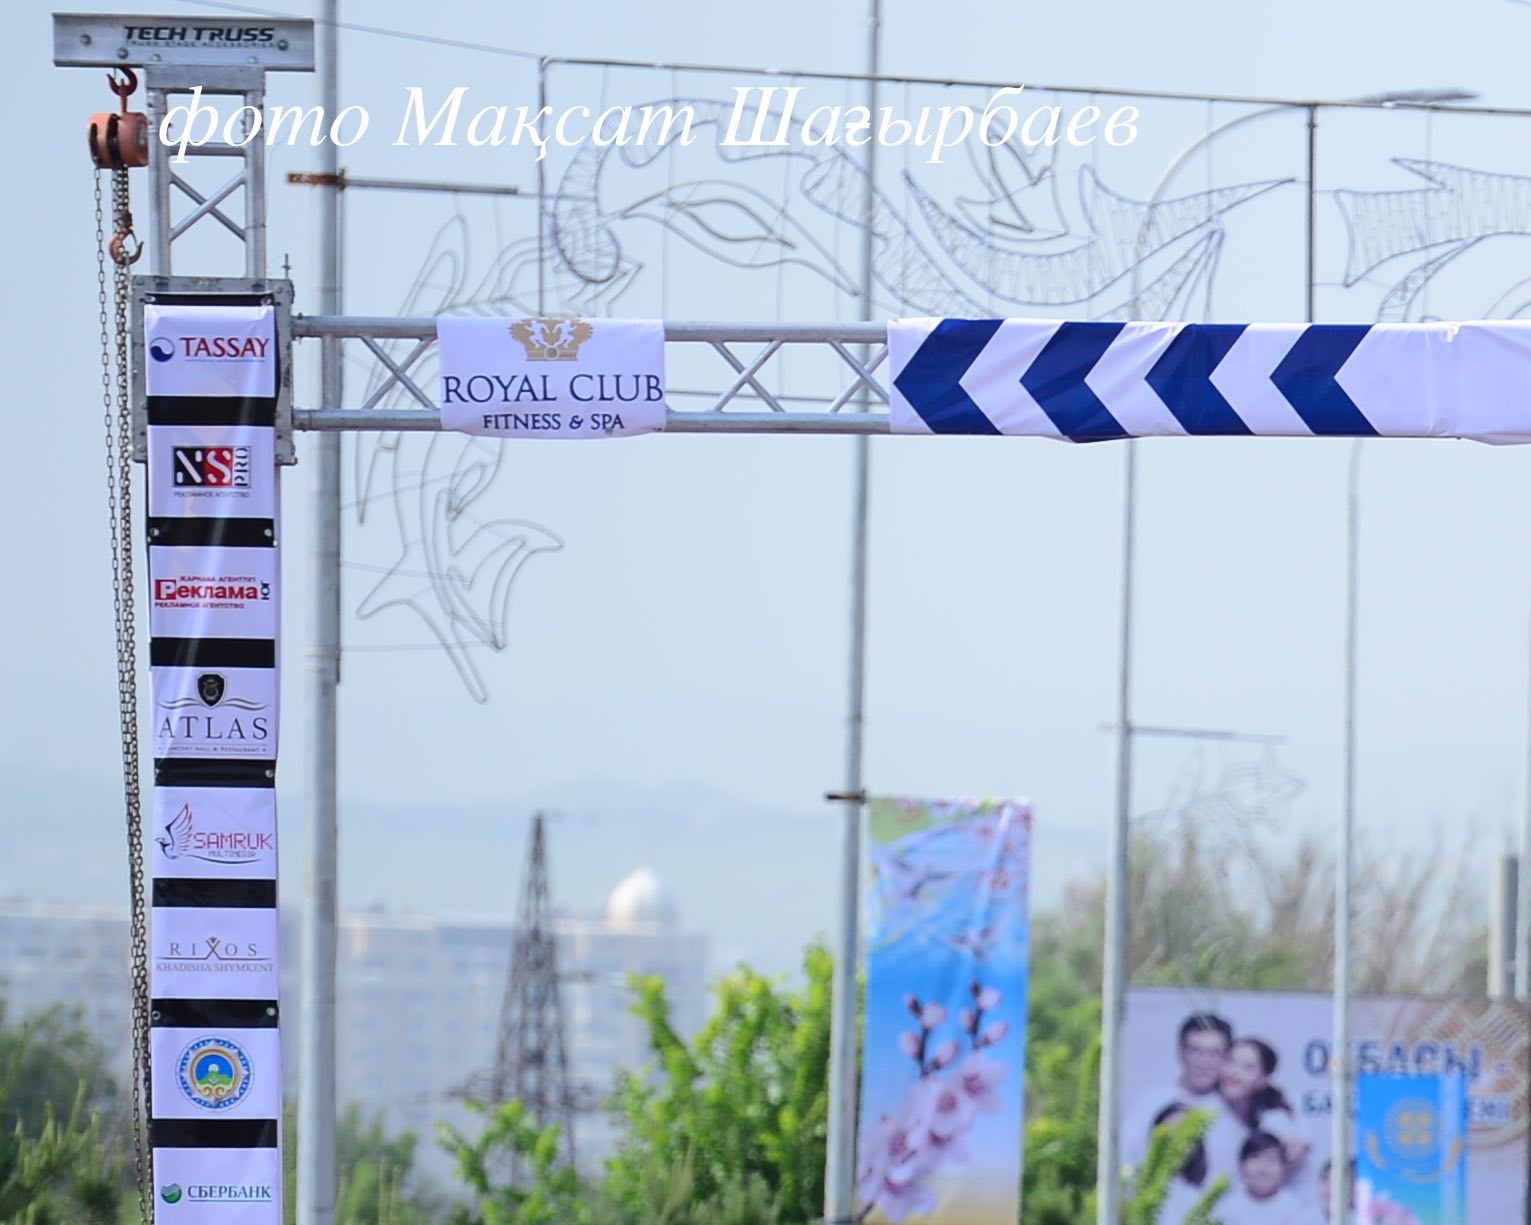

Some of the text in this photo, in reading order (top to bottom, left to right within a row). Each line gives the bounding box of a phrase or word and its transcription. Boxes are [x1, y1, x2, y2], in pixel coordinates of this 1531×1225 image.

[123, 26, 275, 42] TECH TRUSS
[178, 336, 270, 359] TASSAY
[443, 374, 663, 403] ROYAL CLUB
[483, 413, 625, 430] FITNESS & SPA
[155, 578, 258, 600] Реклама
[157, 716, 268, 741] ATLAS
[193, 832, 273, 850] SAMRUK
[169, 936, 258, 957] RIXOS
[156, 962, 274, 973] KHADISHA SHYMKENT
[187, 1185, 272, 1199] СБЕРБАНК
